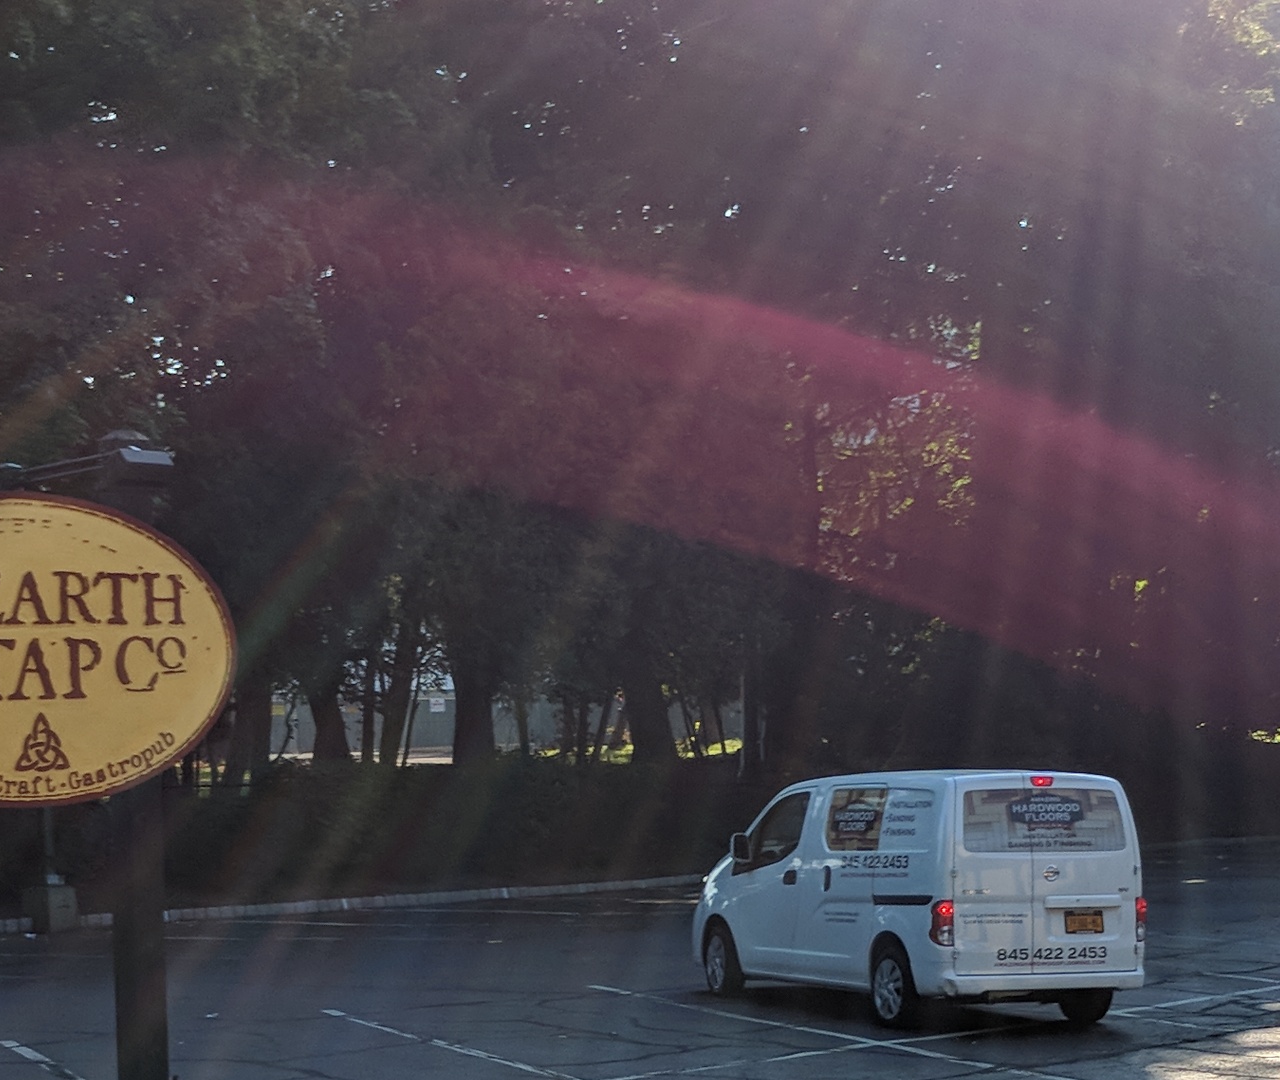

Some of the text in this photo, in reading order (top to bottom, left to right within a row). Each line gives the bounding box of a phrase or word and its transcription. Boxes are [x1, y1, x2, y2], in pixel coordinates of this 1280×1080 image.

[69, 731, 176, 790] Gastropub
[1011, 803, 1081, 813] HARDWOOD
[834, 812, 874, 821] HARDWOOD
[1025, 812, 1070, 821] FLOORS
[839, 822, 866, 831] FLOORS
[996, 946, 1108, 961] 845 422 2453
